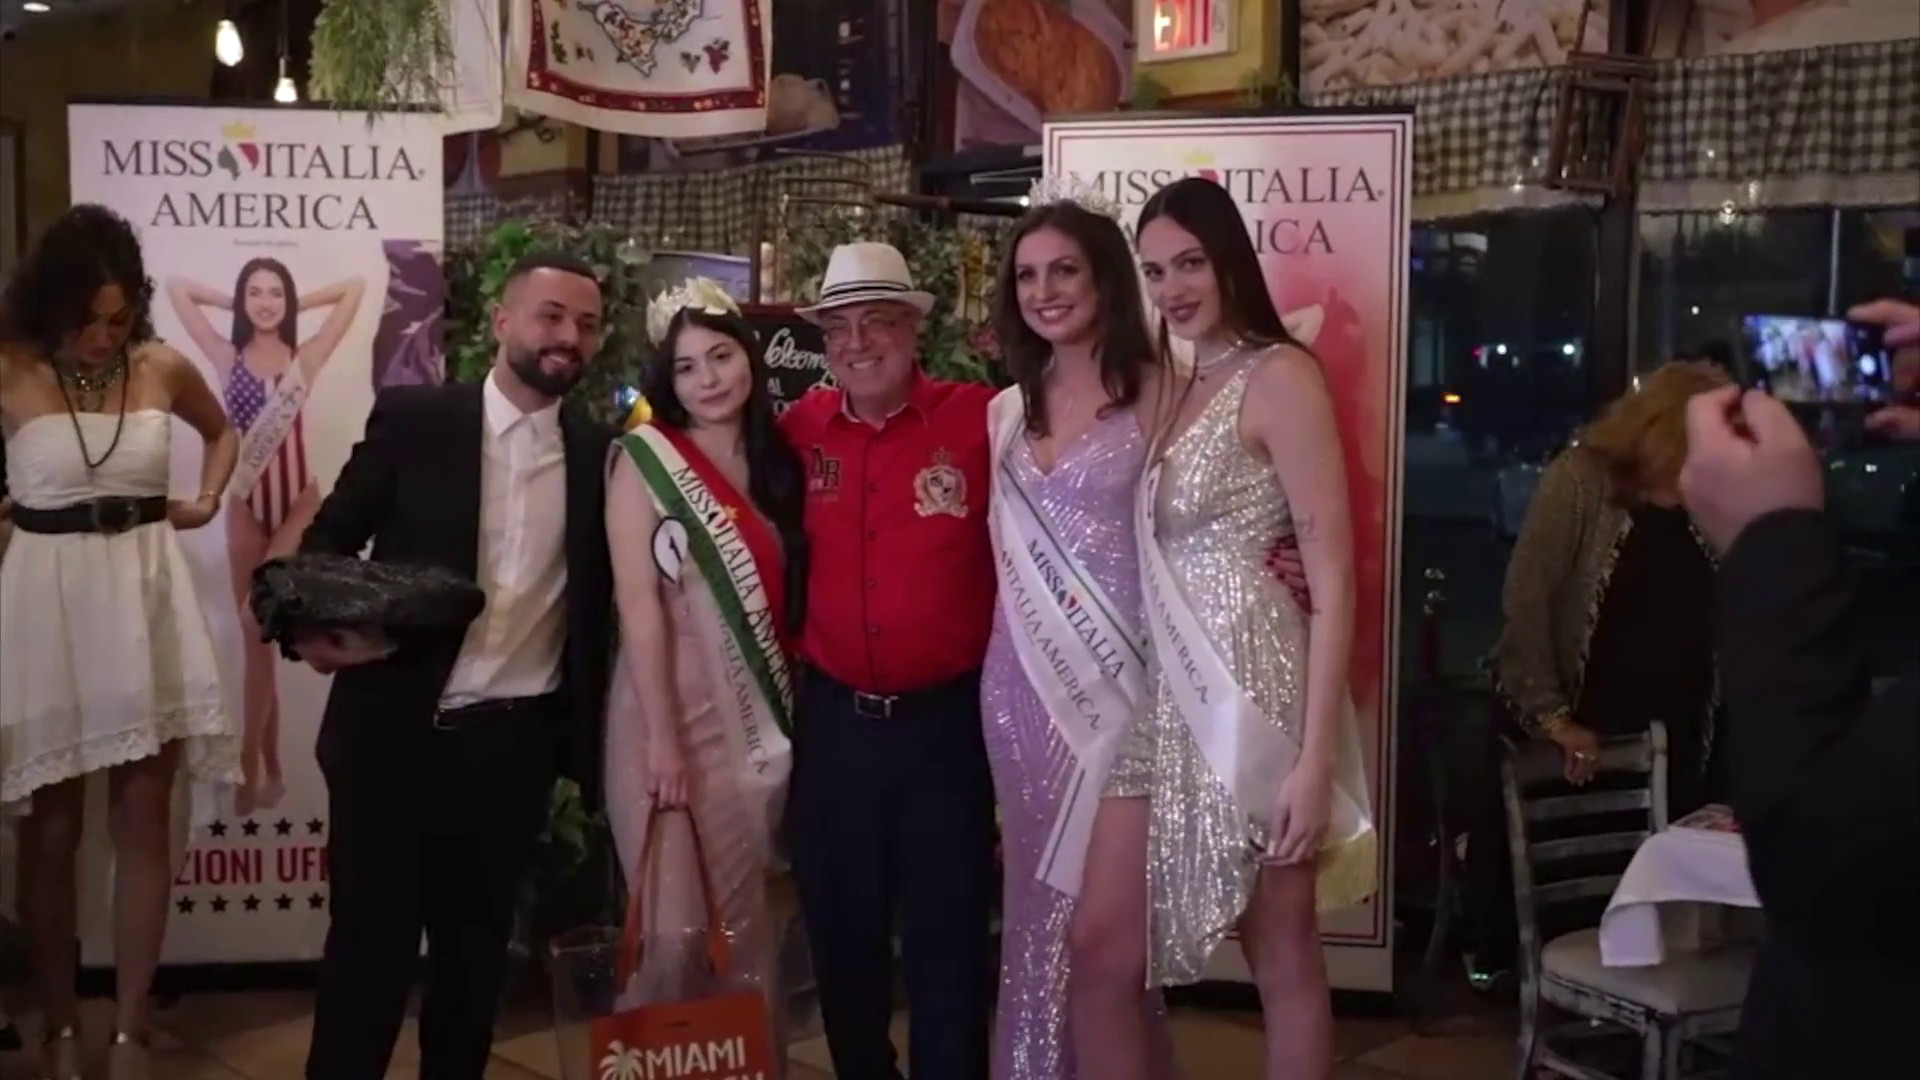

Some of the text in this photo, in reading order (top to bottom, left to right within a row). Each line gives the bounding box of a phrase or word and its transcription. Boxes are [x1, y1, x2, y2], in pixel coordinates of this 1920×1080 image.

[102, 139, 419, 181] MISS ITALIA
[1223, 166, 1379, 204] ITALIA
[150, 192, 378, 231] AMERICA
[672, 466, 713, 515] MISS
[712, 525, 760, 601] ITALIA
[1006, 559, 1043, 635] ITALIA
[1036, 637, 1101, 731] AMERICA
[1027, 539, 1065, 594] MISS
[1066, 604, 1126, 680] ITALIA
[1157, 601, 1209, 705] AMERICA
[735, 681, 770, 776] AMERICA
[645, 1035, 746, 1080] MIAMI
